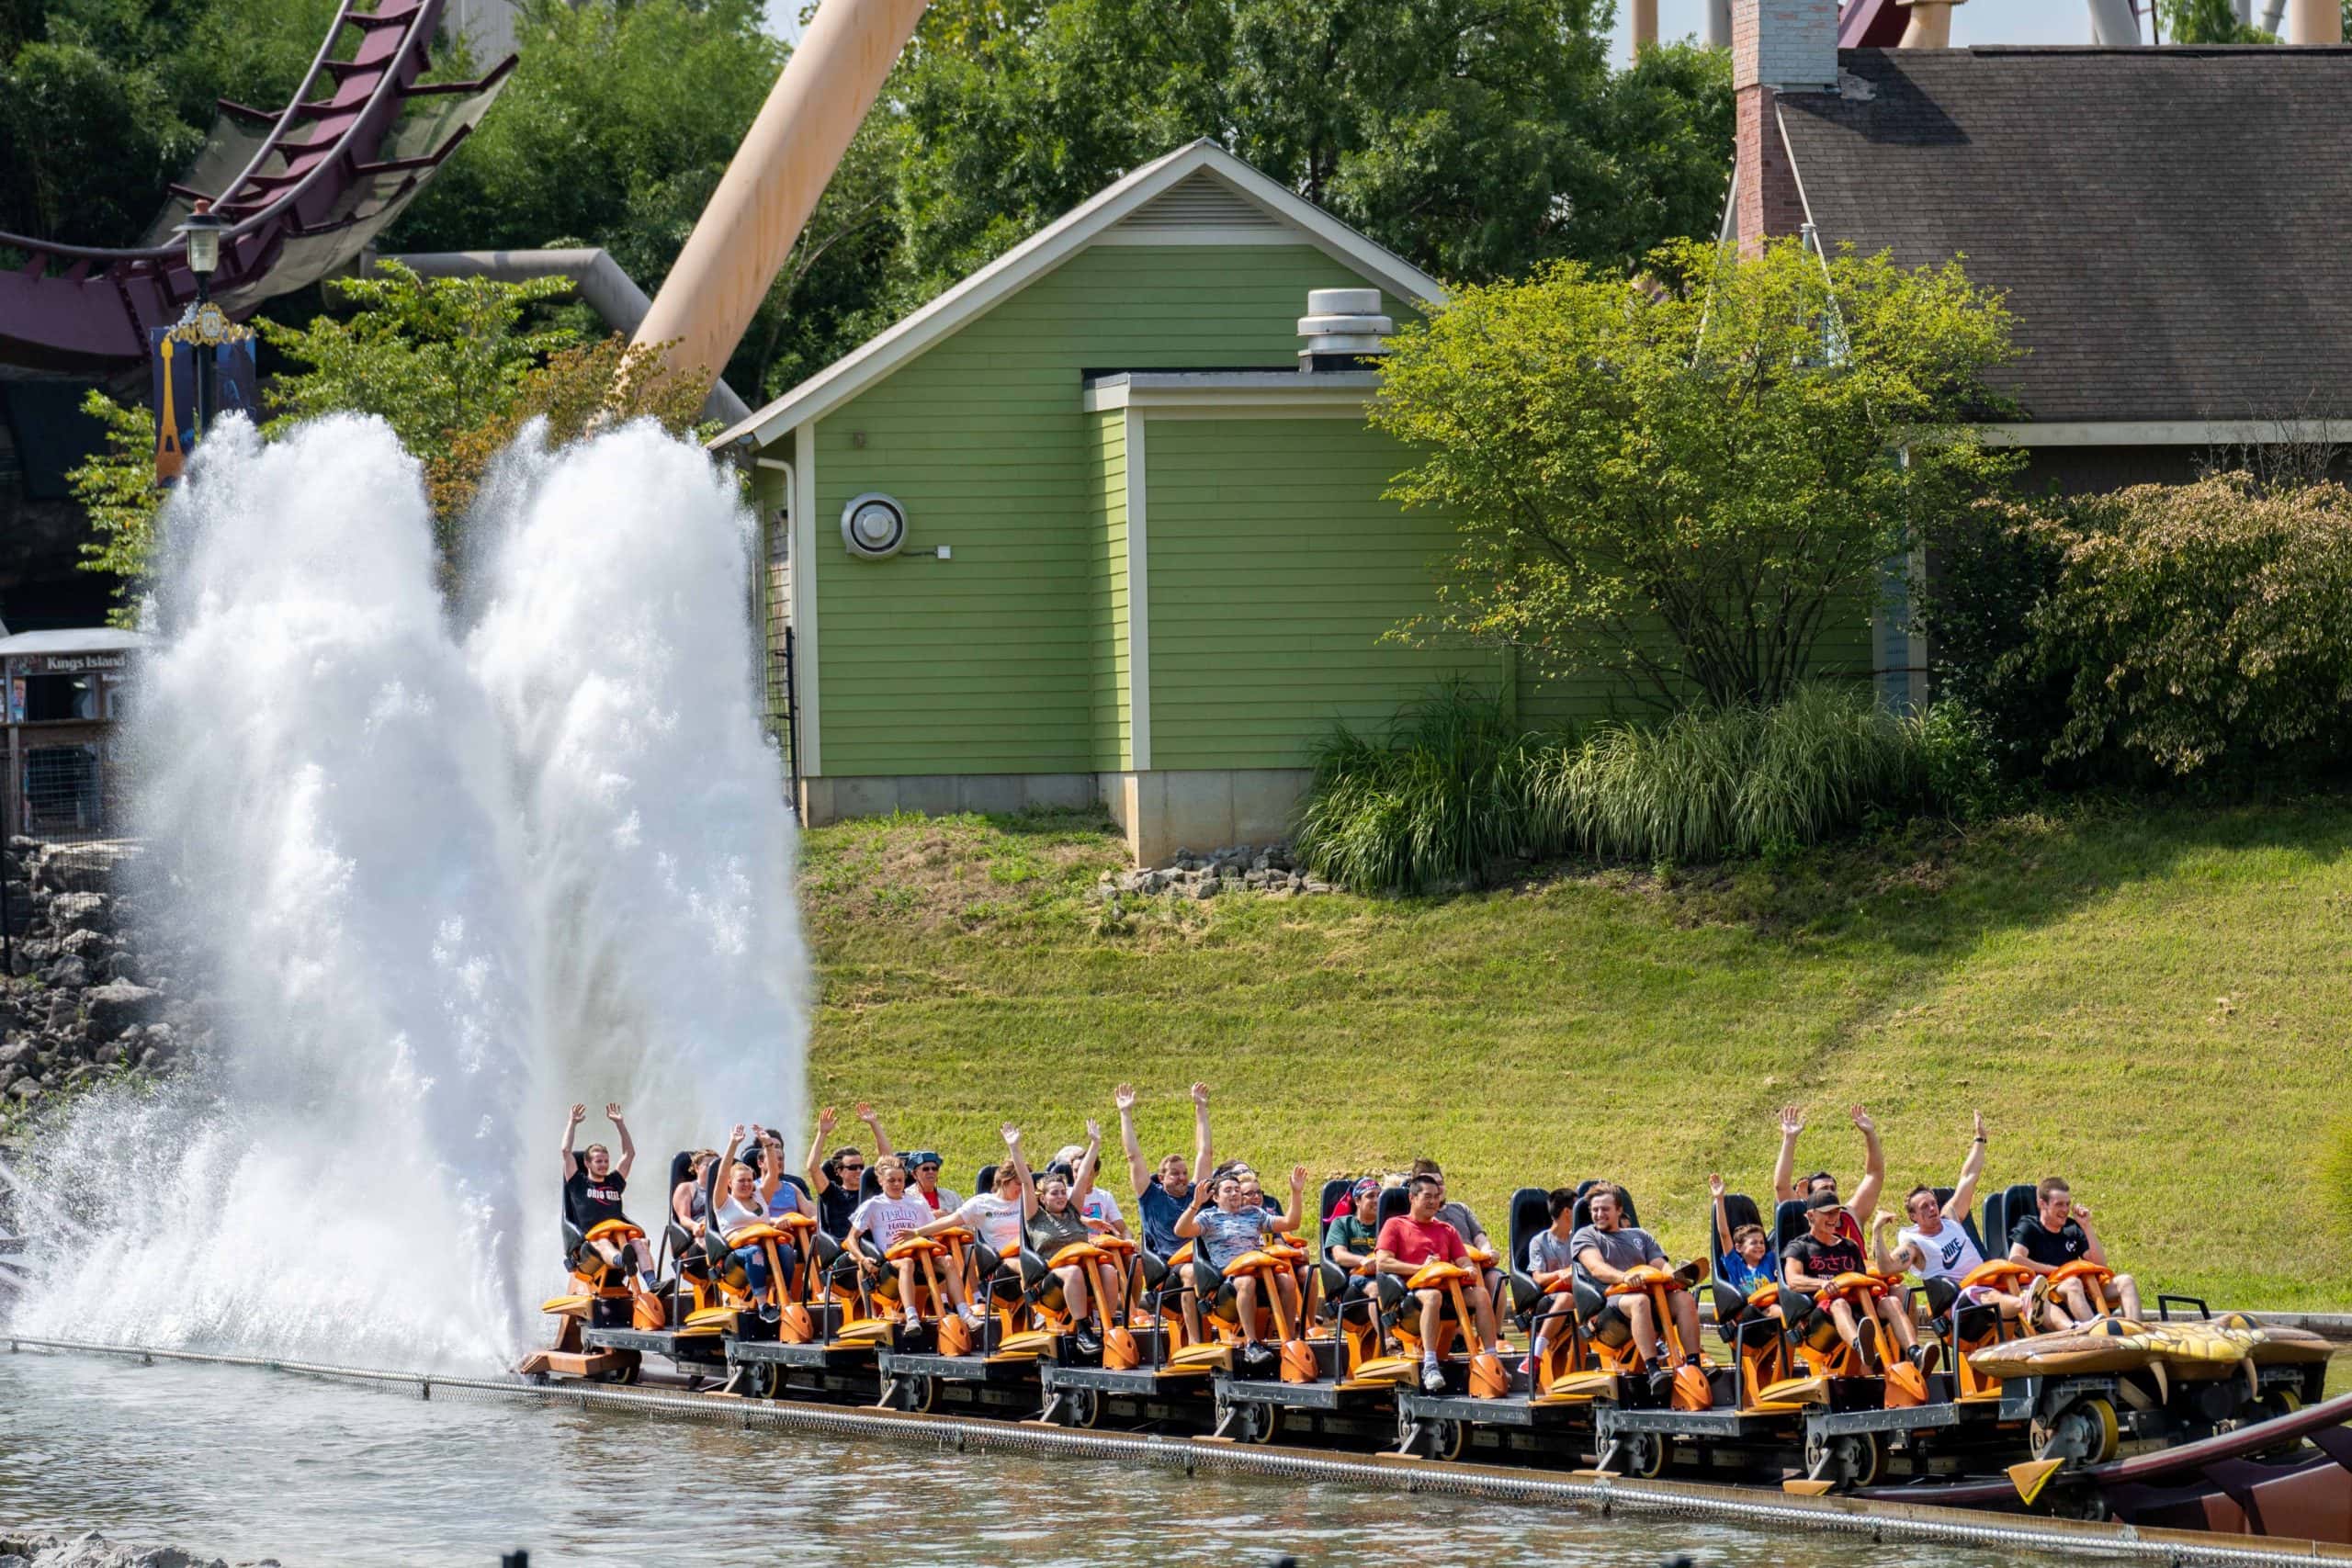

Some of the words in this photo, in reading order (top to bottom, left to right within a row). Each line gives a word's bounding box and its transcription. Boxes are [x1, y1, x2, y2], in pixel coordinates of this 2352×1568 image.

[47, 656, 85, 671] Kings
[85, 653, 126, 669] Island
[1941, 1237, 1960, 1260] NIKE
[1808, 1253, 1856, 1271] あさひ
